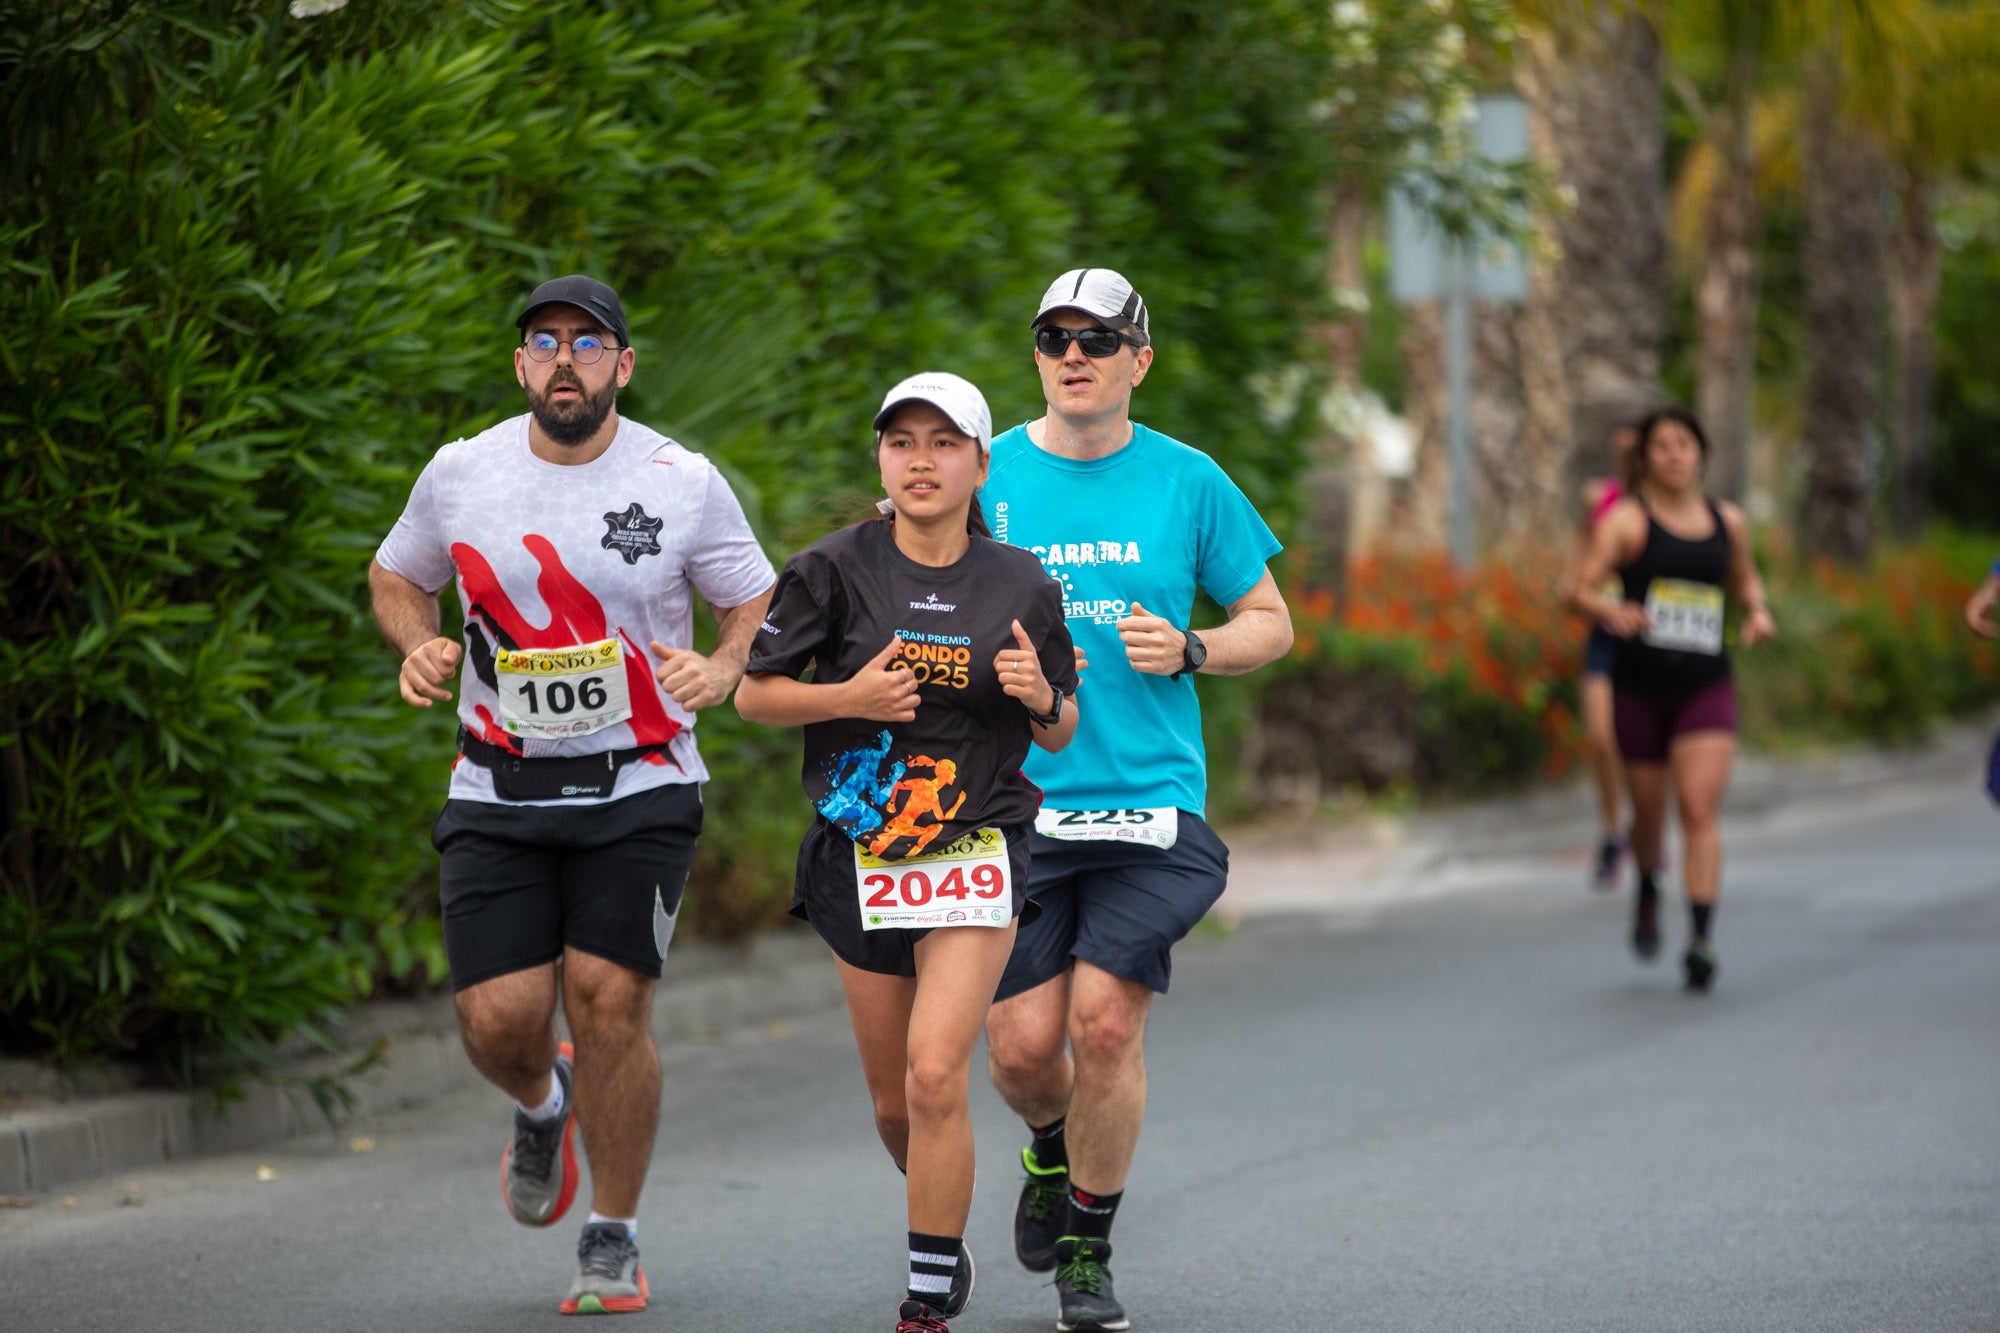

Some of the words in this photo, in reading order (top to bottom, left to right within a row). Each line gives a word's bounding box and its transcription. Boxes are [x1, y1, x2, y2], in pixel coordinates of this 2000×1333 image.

[909, 602, 956, 612] TEAMERGY
[1062, 600, 1126, 615] GRUPO
[894, 629, 925, 641] GRAN
[927, 634, 971, 646] PREMIO
[892, 641, 971, 665] FONDO
[530, 655, 595, 671] FONDO
[519, 677, 607, 714] 106
[863, 864, 1004, 907] 2049
